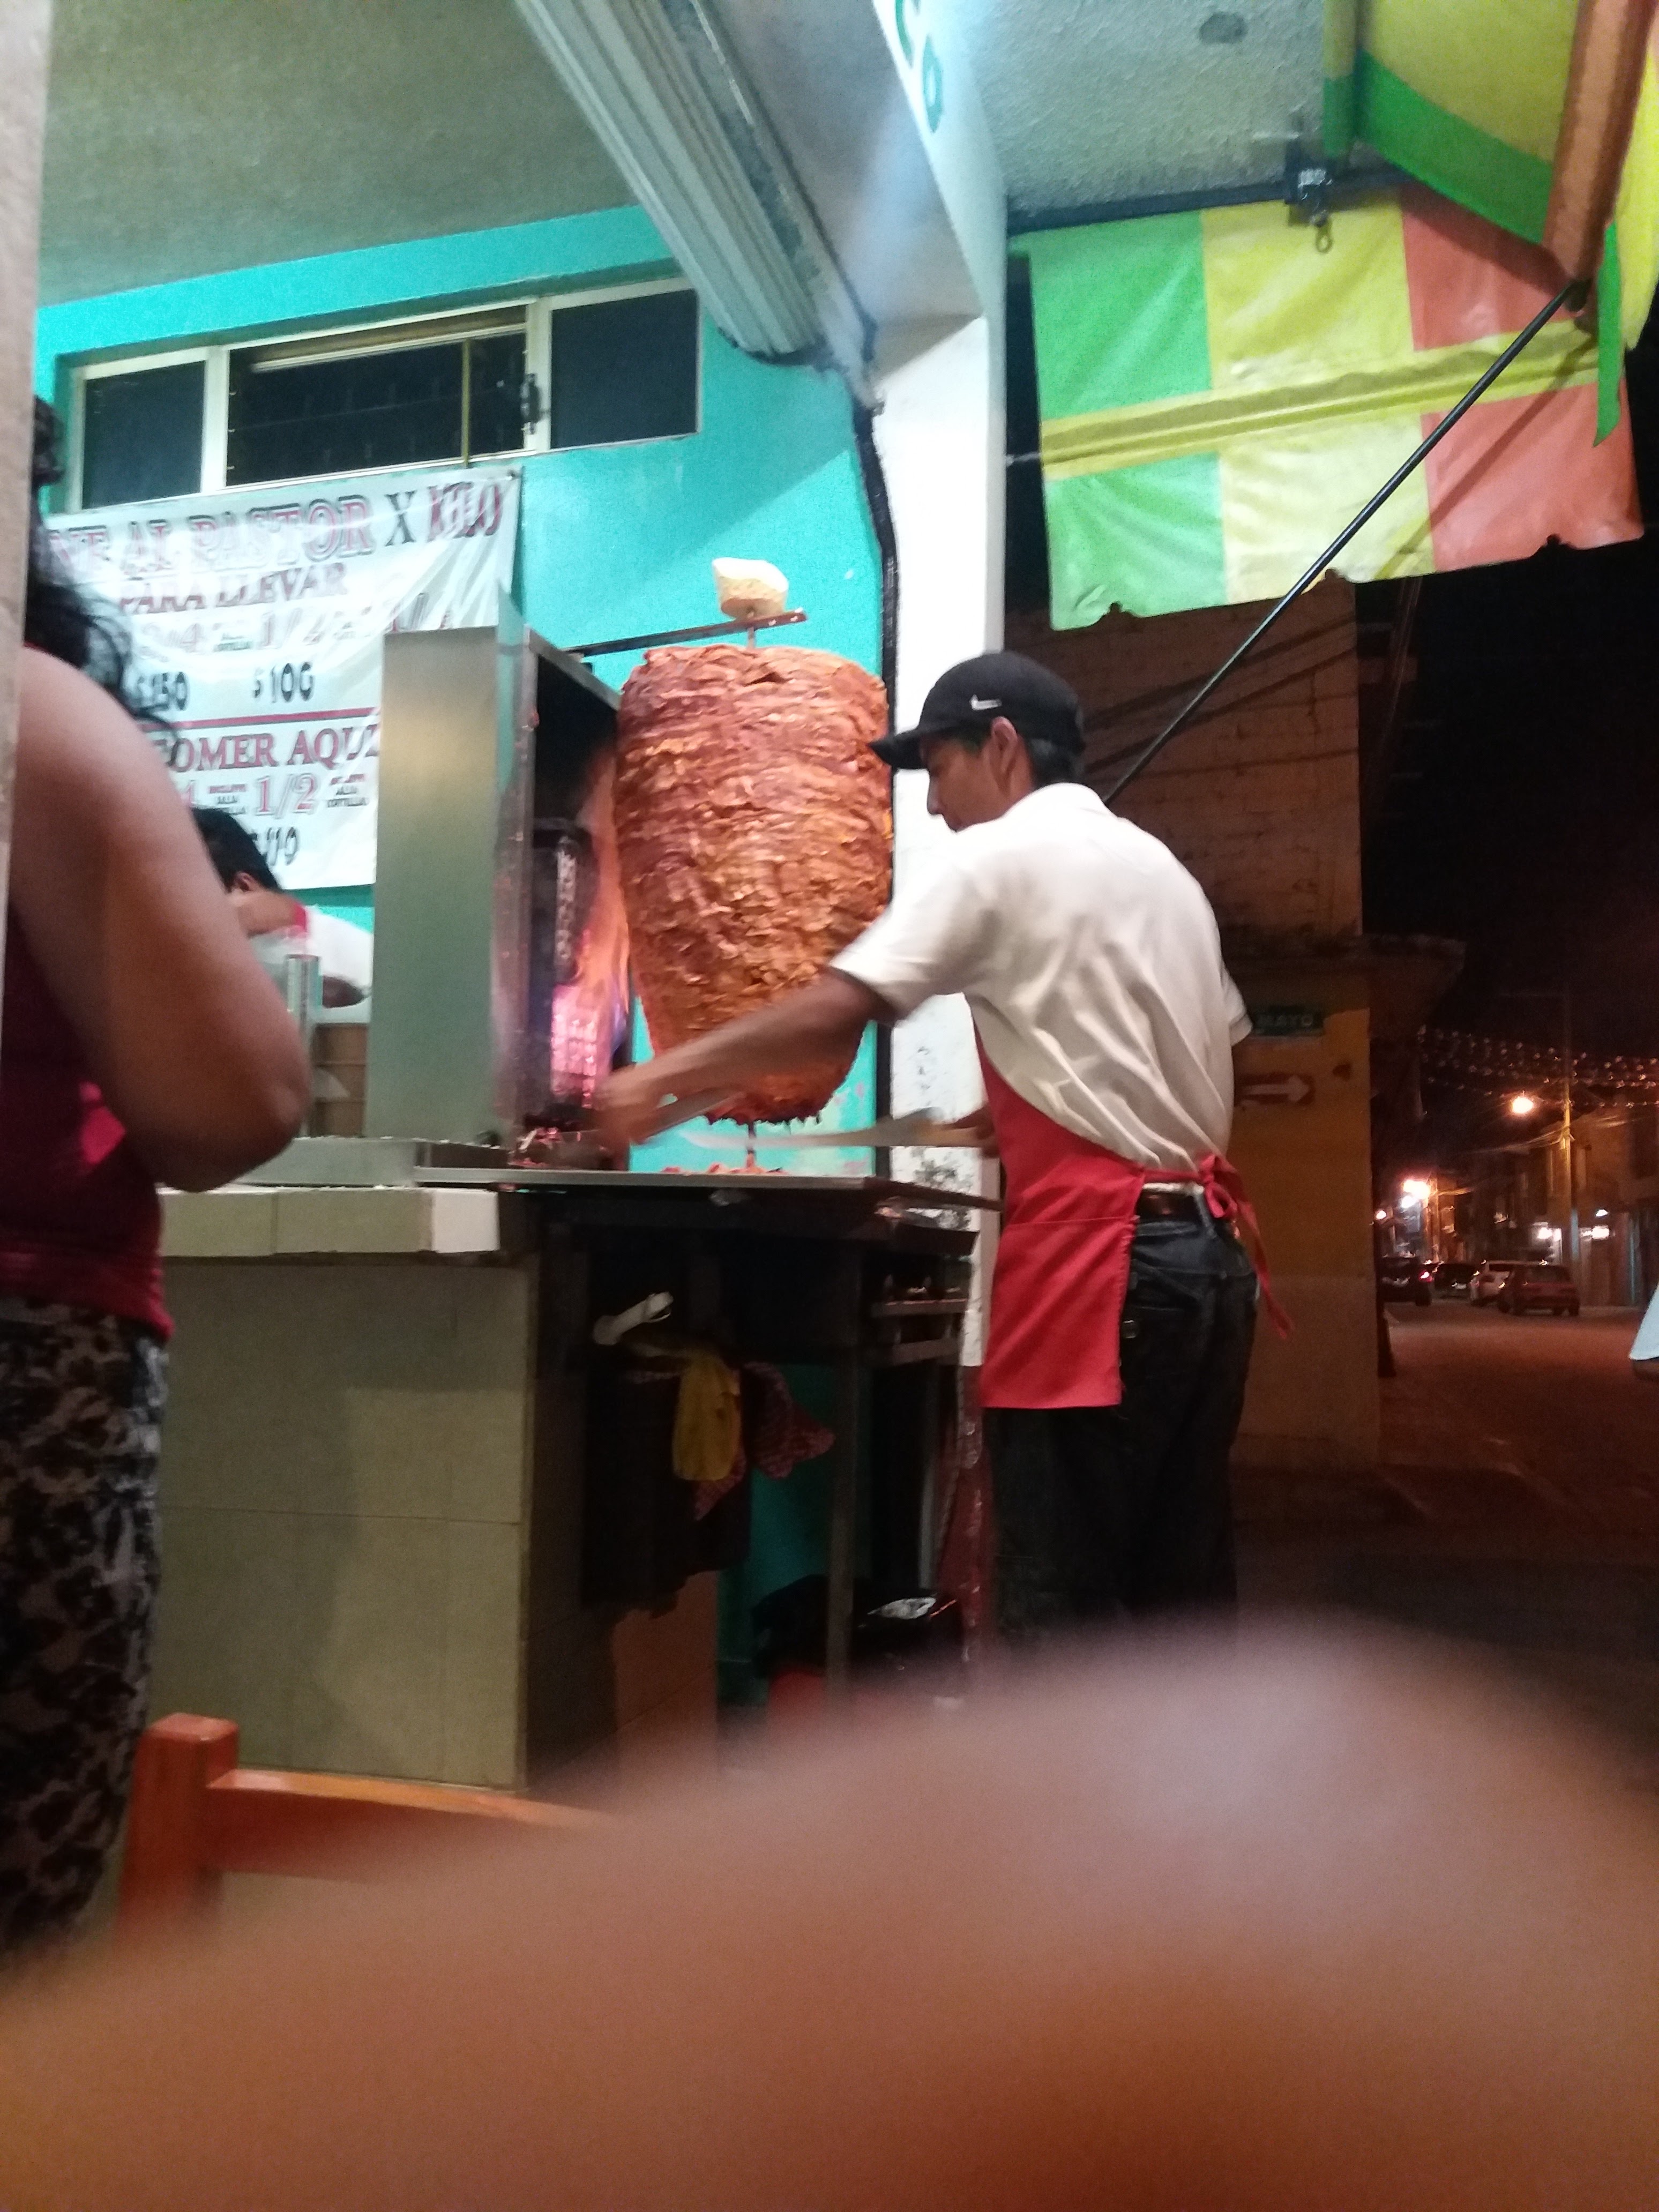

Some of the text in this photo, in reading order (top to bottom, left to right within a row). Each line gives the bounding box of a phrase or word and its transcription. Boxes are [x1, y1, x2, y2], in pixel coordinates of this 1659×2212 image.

[125, 518, 180, 580] AL
[188, 494, 375, 572] PASTOR
[385, 490, 417, 547] X
[215, 562, 347, 608] LLEVAR
[255, 773, 319, 819] 1/2
